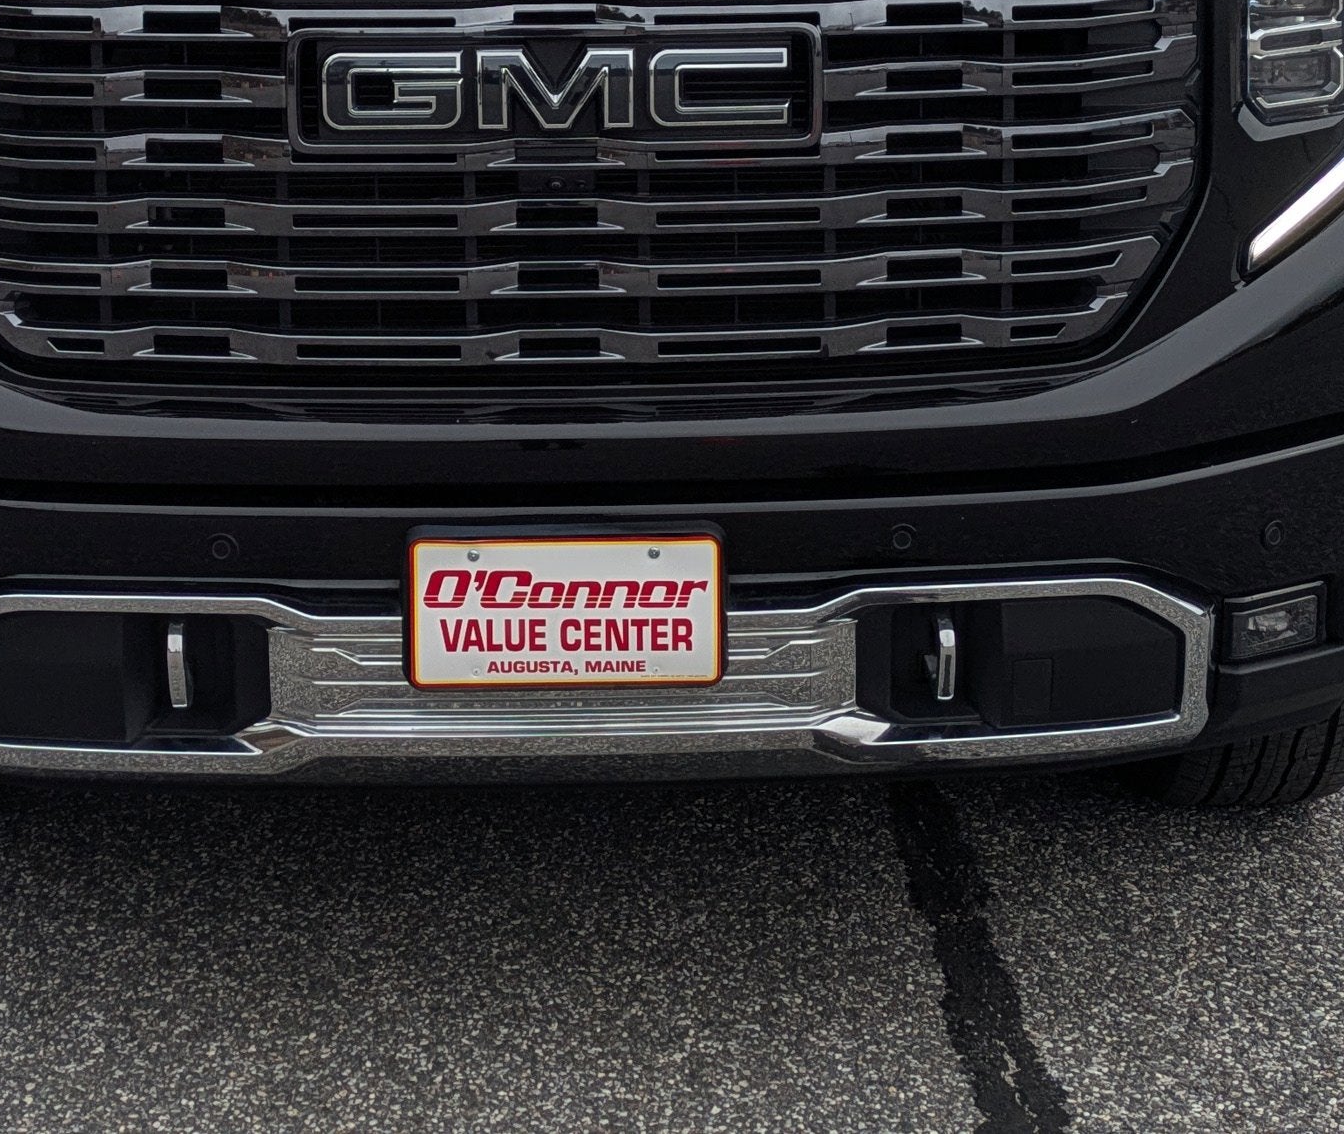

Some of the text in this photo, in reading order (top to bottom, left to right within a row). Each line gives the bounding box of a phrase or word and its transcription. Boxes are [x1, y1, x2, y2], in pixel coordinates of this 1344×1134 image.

[322, 47, 790, 131] GMC
[423, 569, 709, 609] O'Connor
[440, 618, 694, 652] VALUE CENTER
[487, 660, 647, 675] AUGUSTA, MAINE
